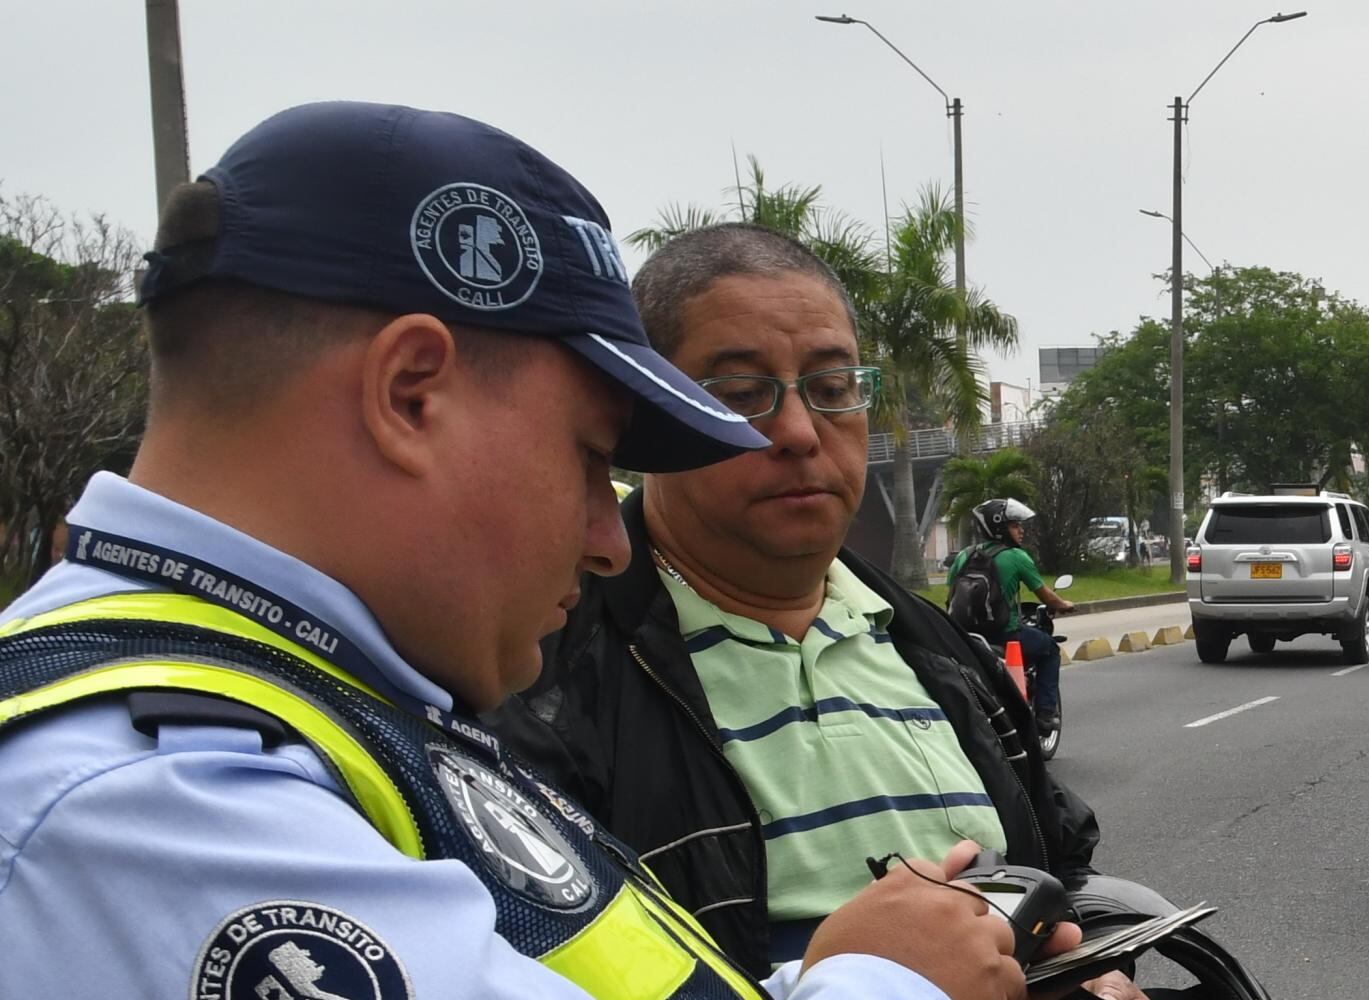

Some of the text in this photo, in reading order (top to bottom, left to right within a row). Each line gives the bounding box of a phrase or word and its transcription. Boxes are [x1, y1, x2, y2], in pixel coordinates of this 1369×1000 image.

[417, 189, 540, 271] AGENTES DE TRANSITO
[457, 287, 505, 307] CALI
[92, 540, 161, 574] AGENTES
[161, 558, 188, 582] DE
[190, 568, 284, 625] TRANSITO
[295, 620, 340, 655] CALI
[226, 912, 264, 946] DE
[261, 906, 385, 962] TRANSITO
